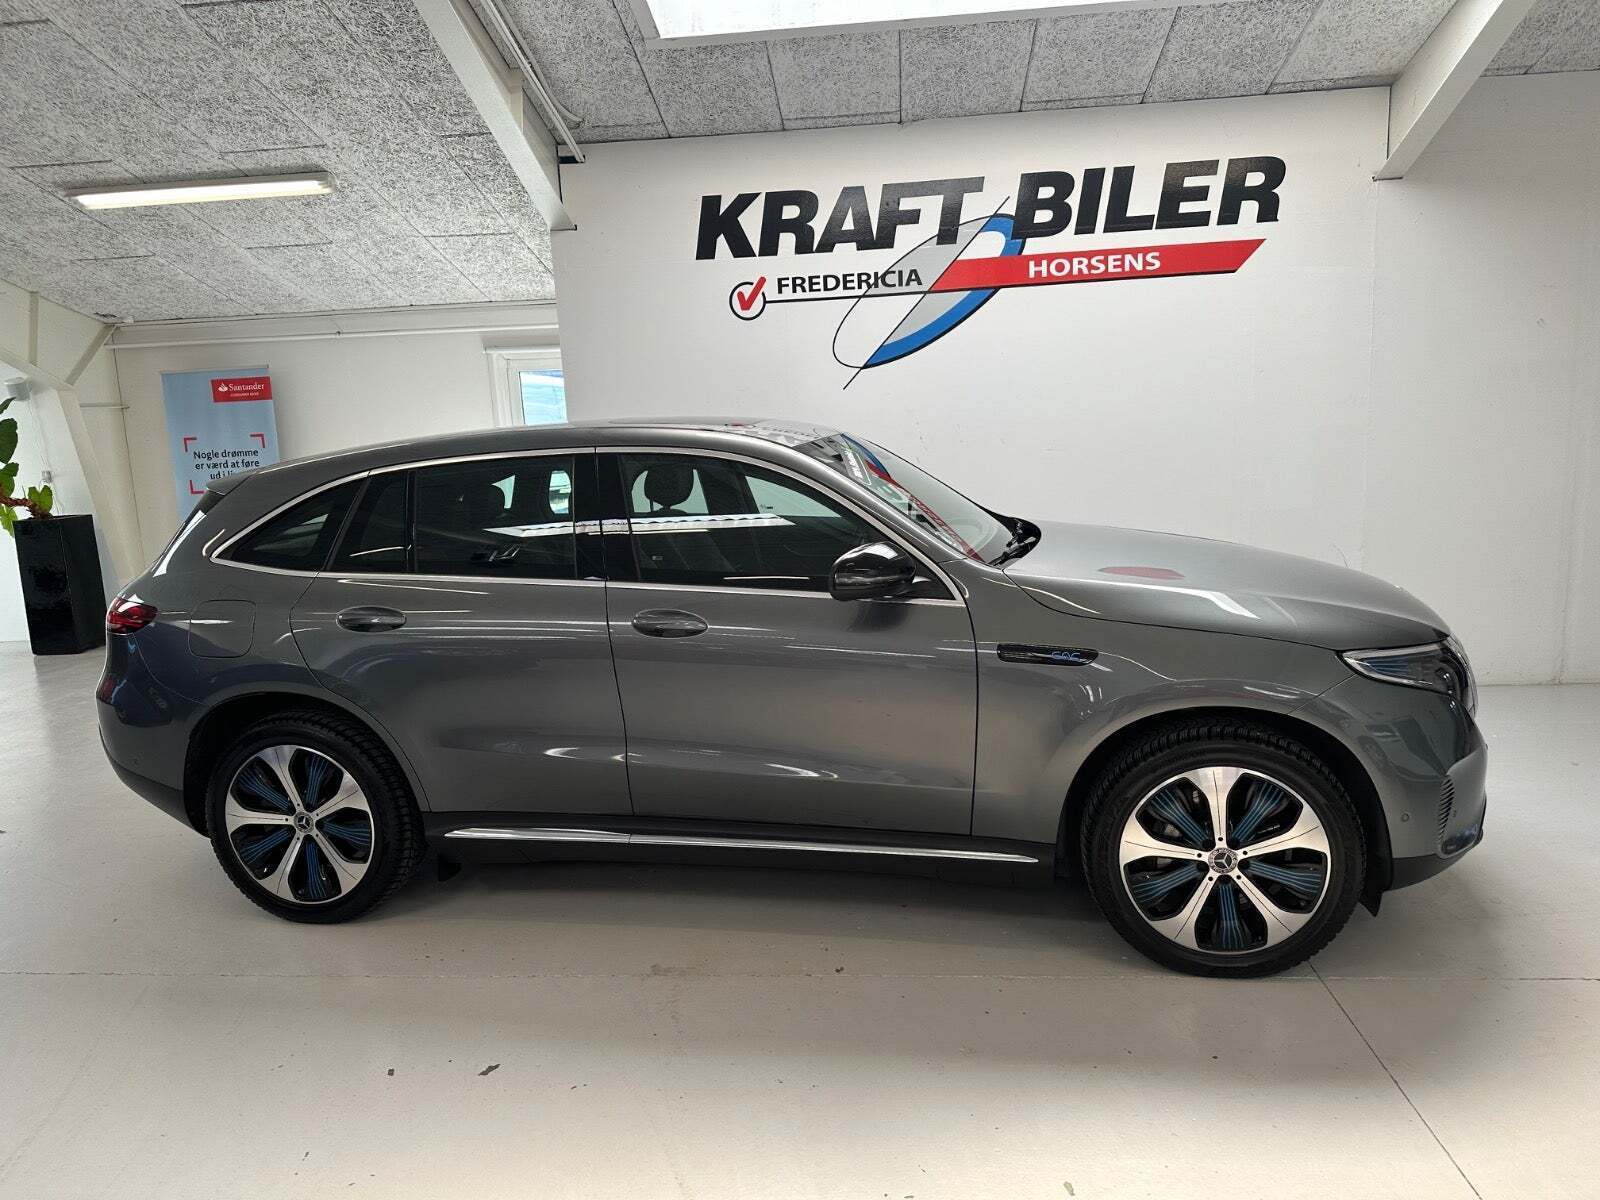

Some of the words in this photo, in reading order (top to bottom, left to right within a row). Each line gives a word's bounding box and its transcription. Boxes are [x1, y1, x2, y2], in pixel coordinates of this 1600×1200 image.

[695, 176, 985, 261] KRAFT
[1010, 155, 1287, 240] BILER
[1028, 251, 1161, 279] HORSENS
[776, 268, 923, 295] FREDERICIA
[228, 382, 265, 392] Santander
[193, 450, 219, 461] Nogle
[221, 449, 259, 458] drømme
[206, 460, 229, 469] værd
[230, 460, 240, 468] at
[241, 459, 260, 468] føre
[210, 471, 221, 480] ud
